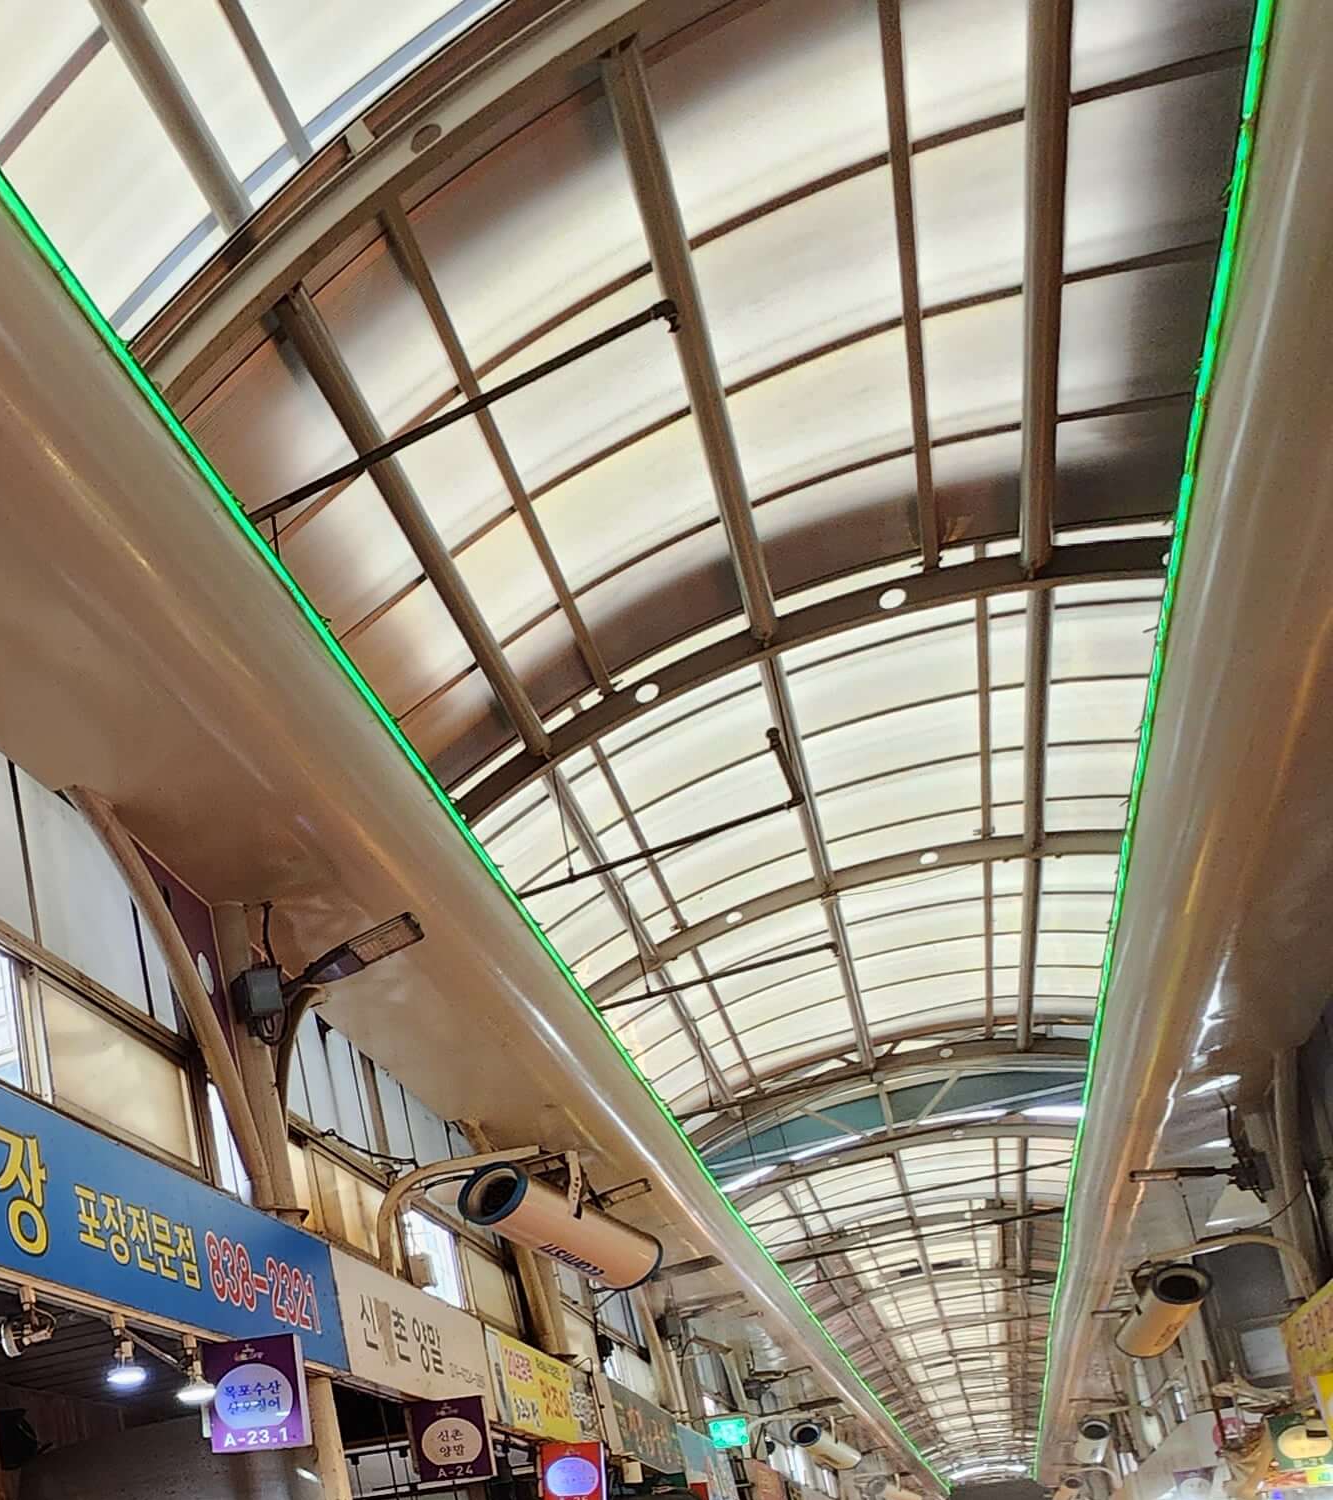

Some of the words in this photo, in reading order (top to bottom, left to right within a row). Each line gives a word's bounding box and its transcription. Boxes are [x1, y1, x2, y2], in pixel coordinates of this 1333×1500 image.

[74, 1183, 202, 1290] 포장전문점
[205, 1231, 322, 1335] 838-2321
[412, 1316, 444, 1376] 양말
[224, 1380, 282, 1399] 목포수산
[224, 1427, 290, 1448] A-23.1
[437, 1428, 464, 1443] 신촌
[439, 1443, 465, 1458] 양말
[437, 1465, 474, 1479] A-24
